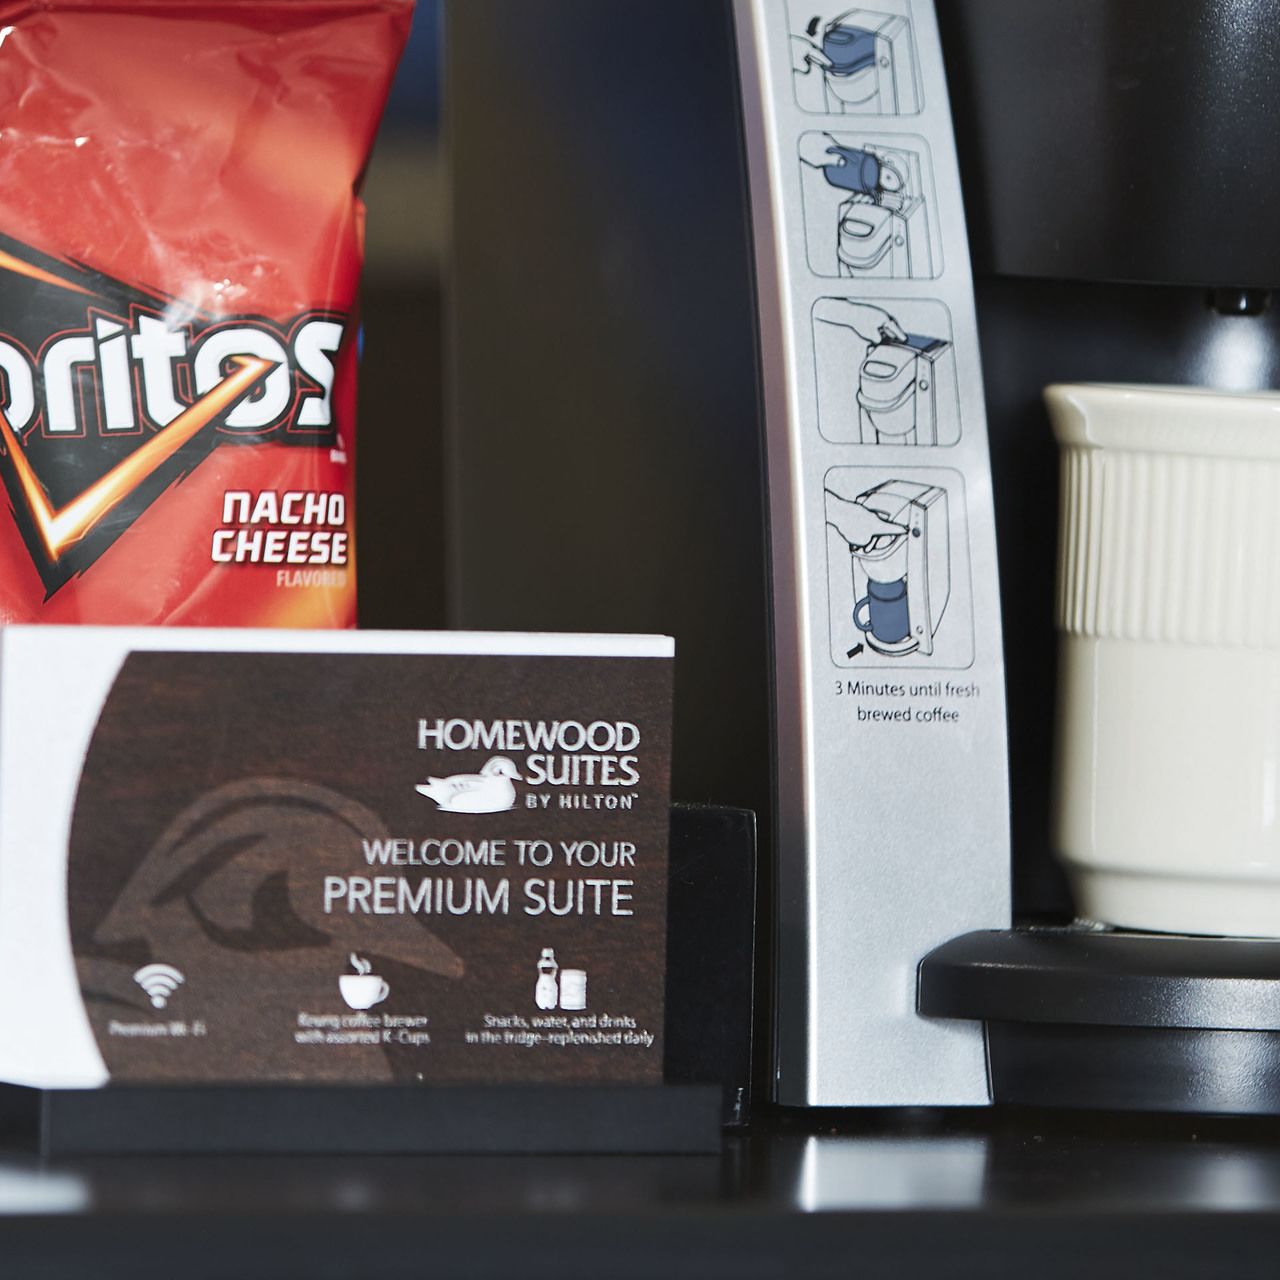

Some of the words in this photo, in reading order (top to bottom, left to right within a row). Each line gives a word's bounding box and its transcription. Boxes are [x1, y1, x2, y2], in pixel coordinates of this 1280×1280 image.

[223, 491, 345, 526] NACHO
[211, 530, 348, 565] CHEESE
[835, 681, 843, 695] 3
[847, 680, 906, 697] Minutes
[909, 682, 941, 697] until
[945, 682, 980, 697] fresh
[857, 707, 911, 721] brewed
[915, 707, 960, 722] coffee
[418, 719, 640, 752] HOMEWOOD
[526, 754, 640, 786] SUITES
[525, 794, 551, 809] BY
[362, 838, 506, 866] WELCOME
[514, 839, 553, 866] TO
[560, 840, 636, 867] YOUR
[324, 875, 510, 915] PREMIUM
[524, 877, 634, 916] SUITE
[571, 1013, 597, 1028] and
[599, 1012, 637, 1028] drinks
[624, 1028, 655, 1048] daily
